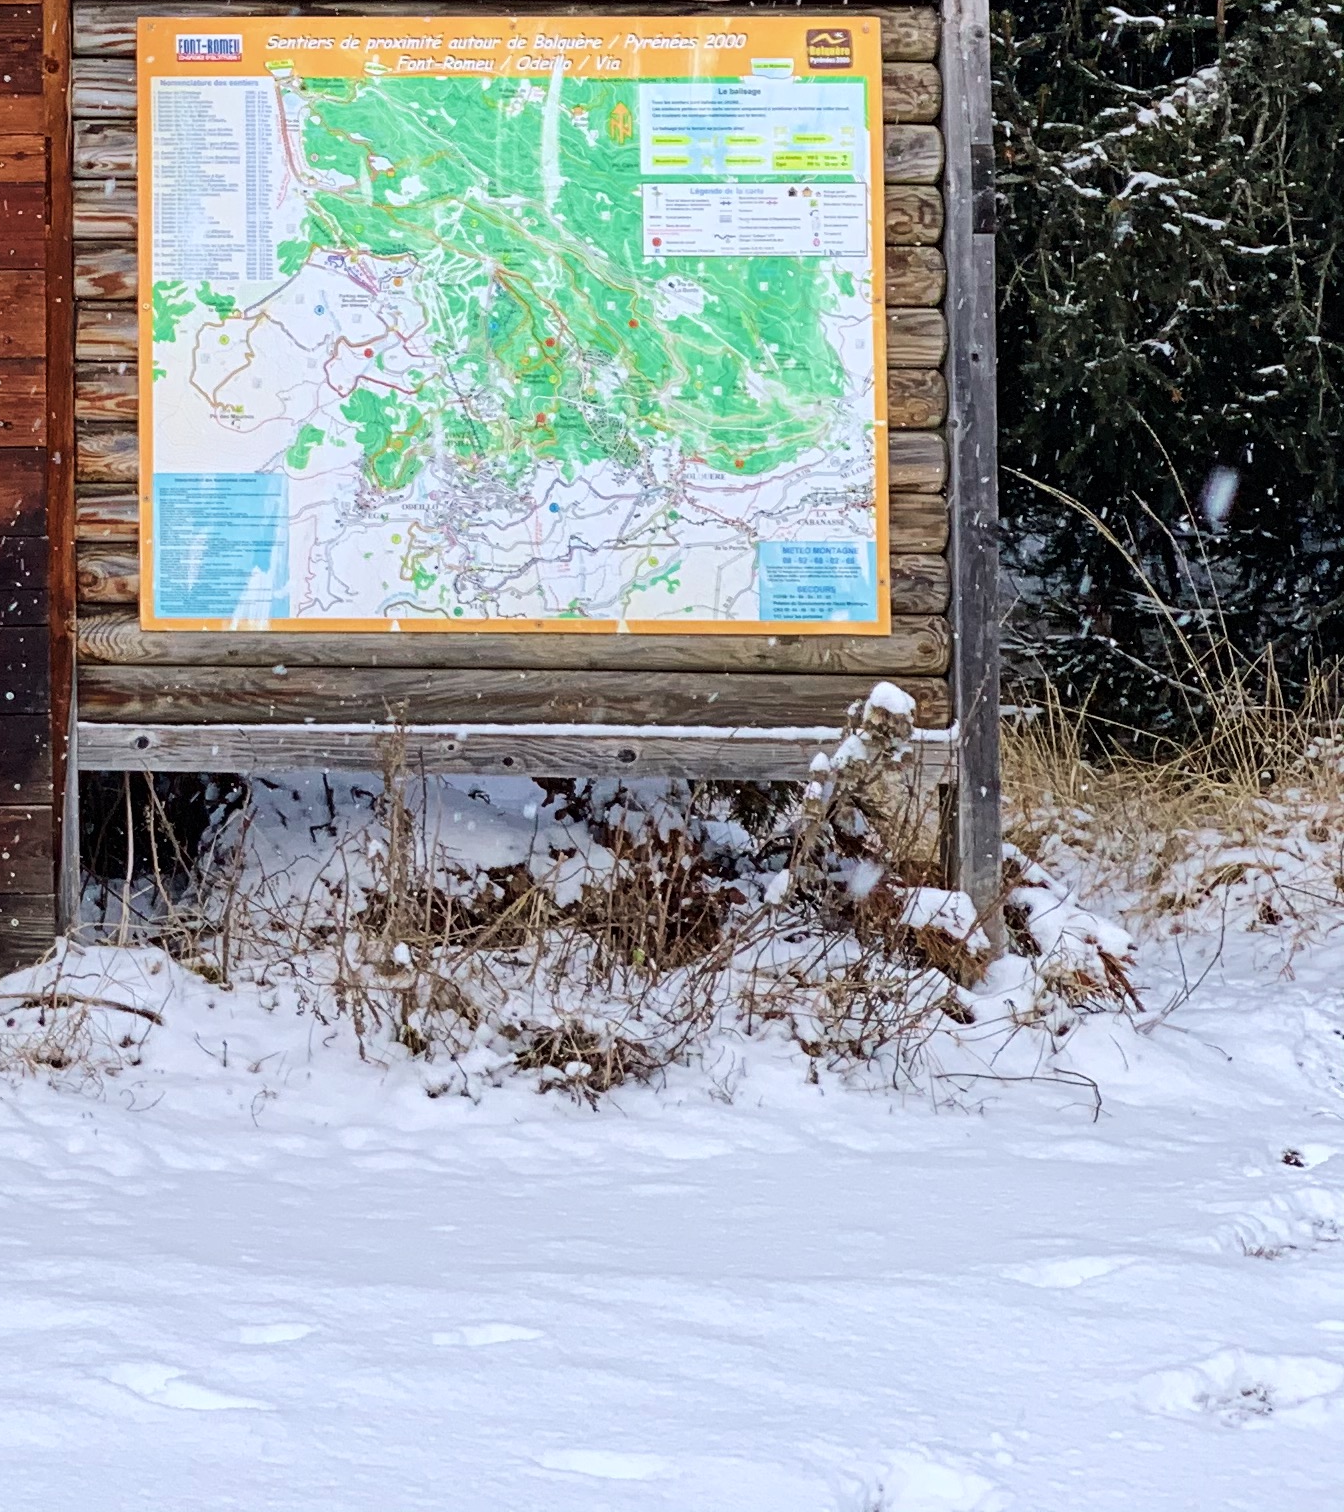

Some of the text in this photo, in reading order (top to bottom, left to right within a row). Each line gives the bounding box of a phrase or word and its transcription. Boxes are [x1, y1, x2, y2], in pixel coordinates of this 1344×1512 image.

[178, 39, 240, 54] FONT-ROMEU
[266, 34, 335, 50] Sentiers
[340, 33, 361, 50] de
[365, 33, 444, 54] proximité
[448, 35, 502, 50] autour
[507, 34, 528, 50] de
[533, 33, 603, 54] Bolquère
[624, 32, 698, 53] Pyrénées
[703, 33, 747, 50] 2000
[397, 53, 496, 71] Font-Romeu
[596, 55, 622, 71] Via
